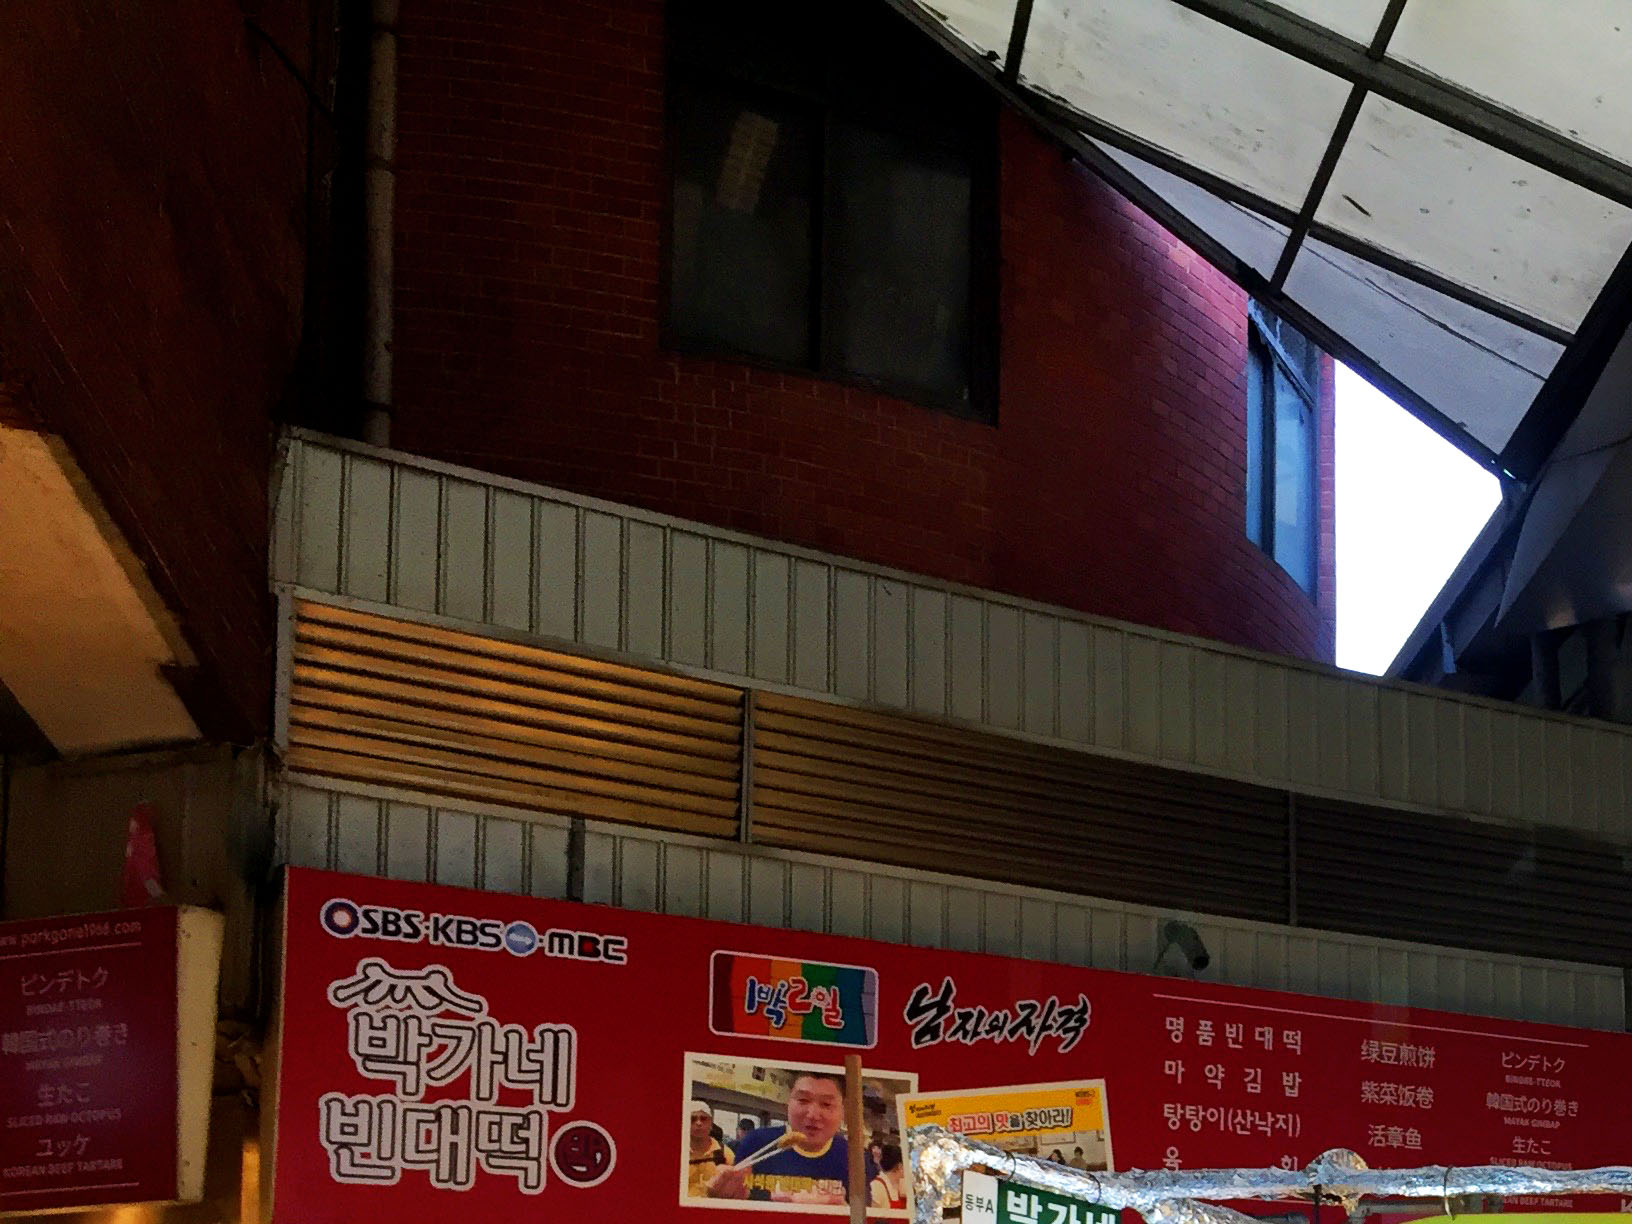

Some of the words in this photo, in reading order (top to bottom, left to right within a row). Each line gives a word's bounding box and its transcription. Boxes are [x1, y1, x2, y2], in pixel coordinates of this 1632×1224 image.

[359, 908, 422, 940] SBS
[431, 915, 504, 949] KBS
[350, 1011, 576, 1110] 박가네
[1360, 1039, 1436, 1069] 绿豆煎饼
[1501, 1051, 1566, 1073] ピンデトク
[1360, 1080, 1435, 1110] 紫菜饭卷
[1486, 1091, 1579, 1117] 韓国式のり巻き
[1162, 1102, 1302, 1138] 탕탕이(산낙지)
[321, 1094, 545, 1192] 빈대떡
[1367, 1123, 1423, 1150] 活章鱼
[1512, 1136, 1552, 1155] 生たこ
